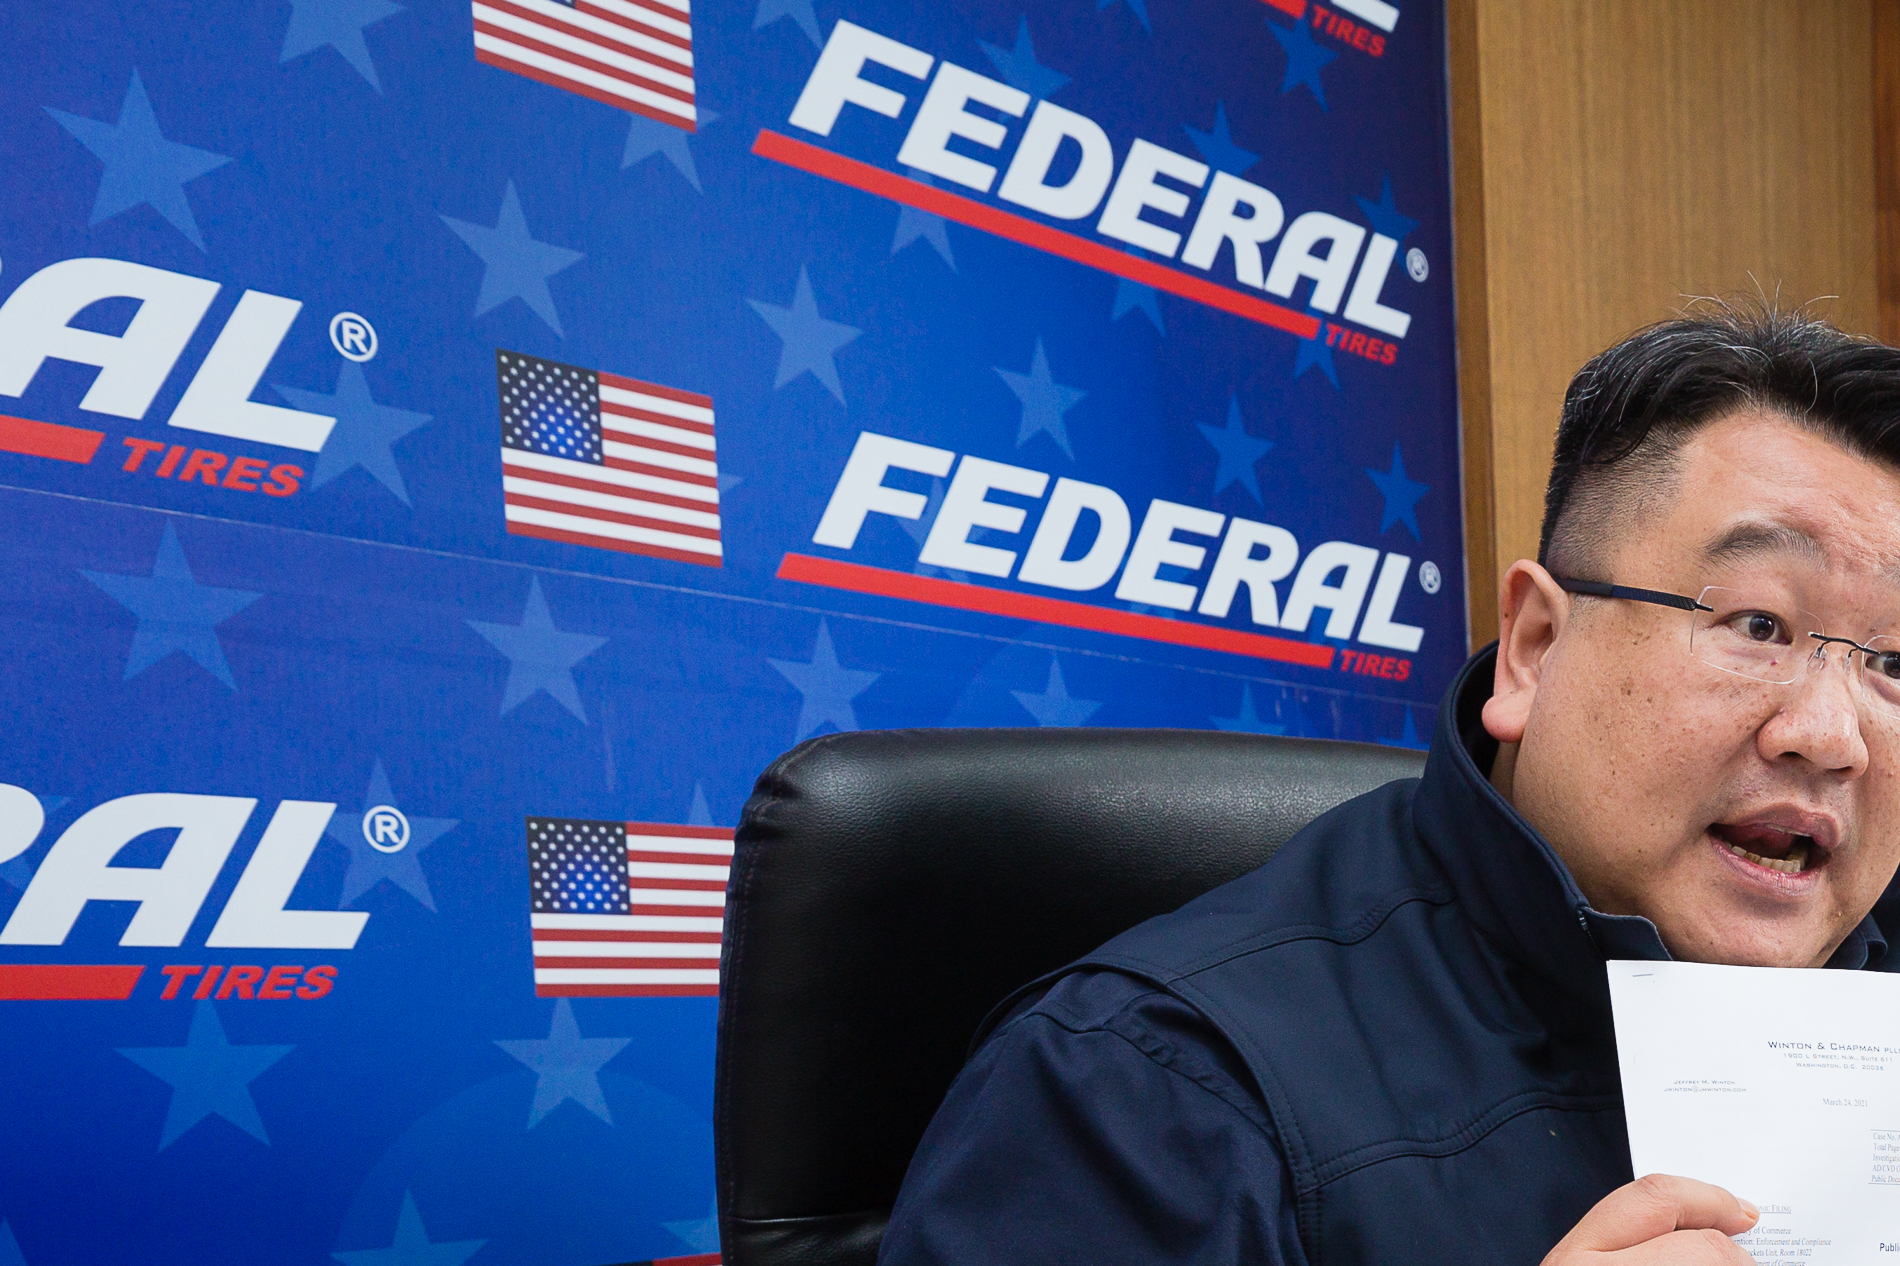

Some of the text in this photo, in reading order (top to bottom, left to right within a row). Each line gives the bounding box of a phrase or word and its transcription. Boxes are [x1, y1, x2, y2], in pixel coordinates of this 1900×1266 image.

[1311, 6, 1386, 58] TIRES
[788, 19, 1411, 339] FEDERAL
[1325, 321, 1397, 366] TIRES
[121, 437, 304, 497] TIRES
[812, 430, 1424, 652] FEDERAL
[1340, 650, 1412, 681] TIRES
[161, 965, 338, 1000] TIRES
[1767, 1041, 1812, 1049] WINTON
[1817, 1042, 1825, 1050] &
[1829, 1042, 1880, 1052] CHAPMAN
[1843, 1098, 1855, 1106] 24,
[1853, 1099, 1868, 1107] 2021
[1873, 1142, 1887, 1150] Total
[1871, 1164, 1896, 1172] AD/CVD
[1871, 1176, 1887, 1184] Public
